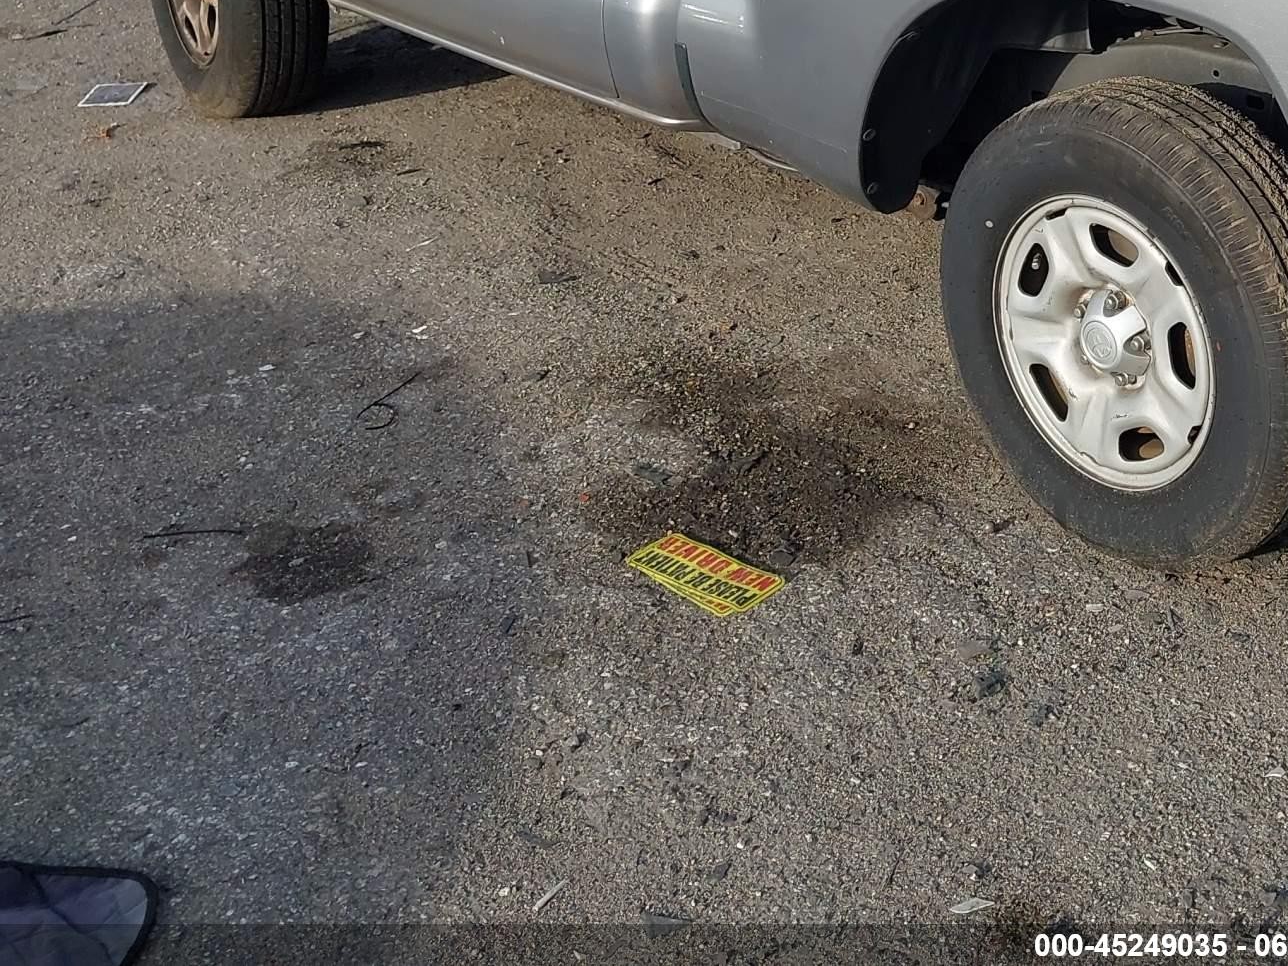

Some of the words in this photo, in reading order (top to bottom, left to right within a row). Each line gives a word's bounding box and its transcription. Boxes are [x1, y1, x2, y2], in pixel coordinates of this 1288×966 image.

[634, 549, 692, 580] PATIENT
[657, 536, 733, 575] DRIVER
[685, 571, 711, 588] BE
[701, 578, 758, 607] PLEASE
[726, 567, 777, 592] NEW
